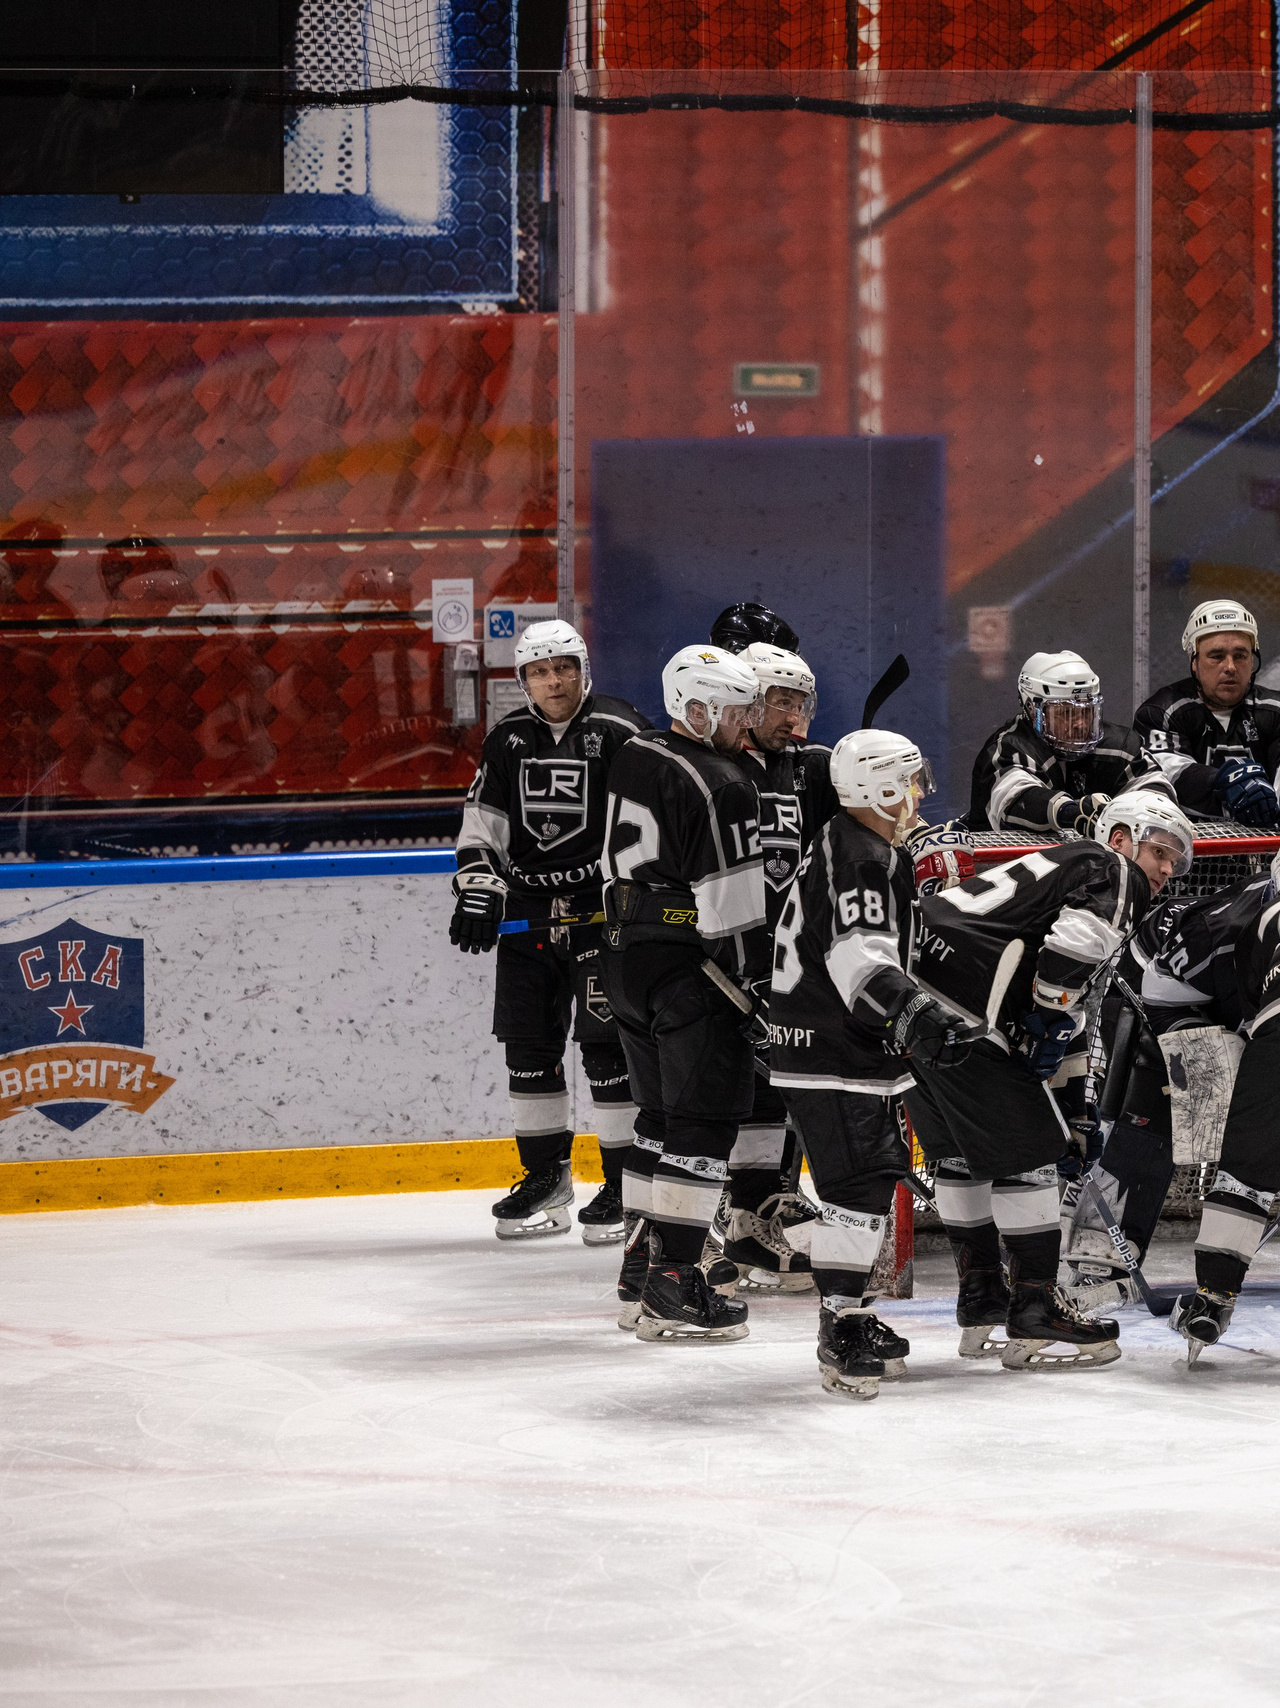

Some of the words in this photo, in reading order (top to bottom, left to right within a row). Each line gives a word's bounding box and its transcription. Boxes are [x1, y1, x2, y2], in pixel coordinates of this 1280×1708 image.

[872, 760, 896, 771] BAUER
[1227, 765, 1262, 783] CC
[525, 769, 581, 799] LR
[466, 875, 507, 890] CC
[838, 888, 885, 926] 68
[18, 940, 121, 990] СКА
[1108, 1224, 1138, 1271] BAUER
